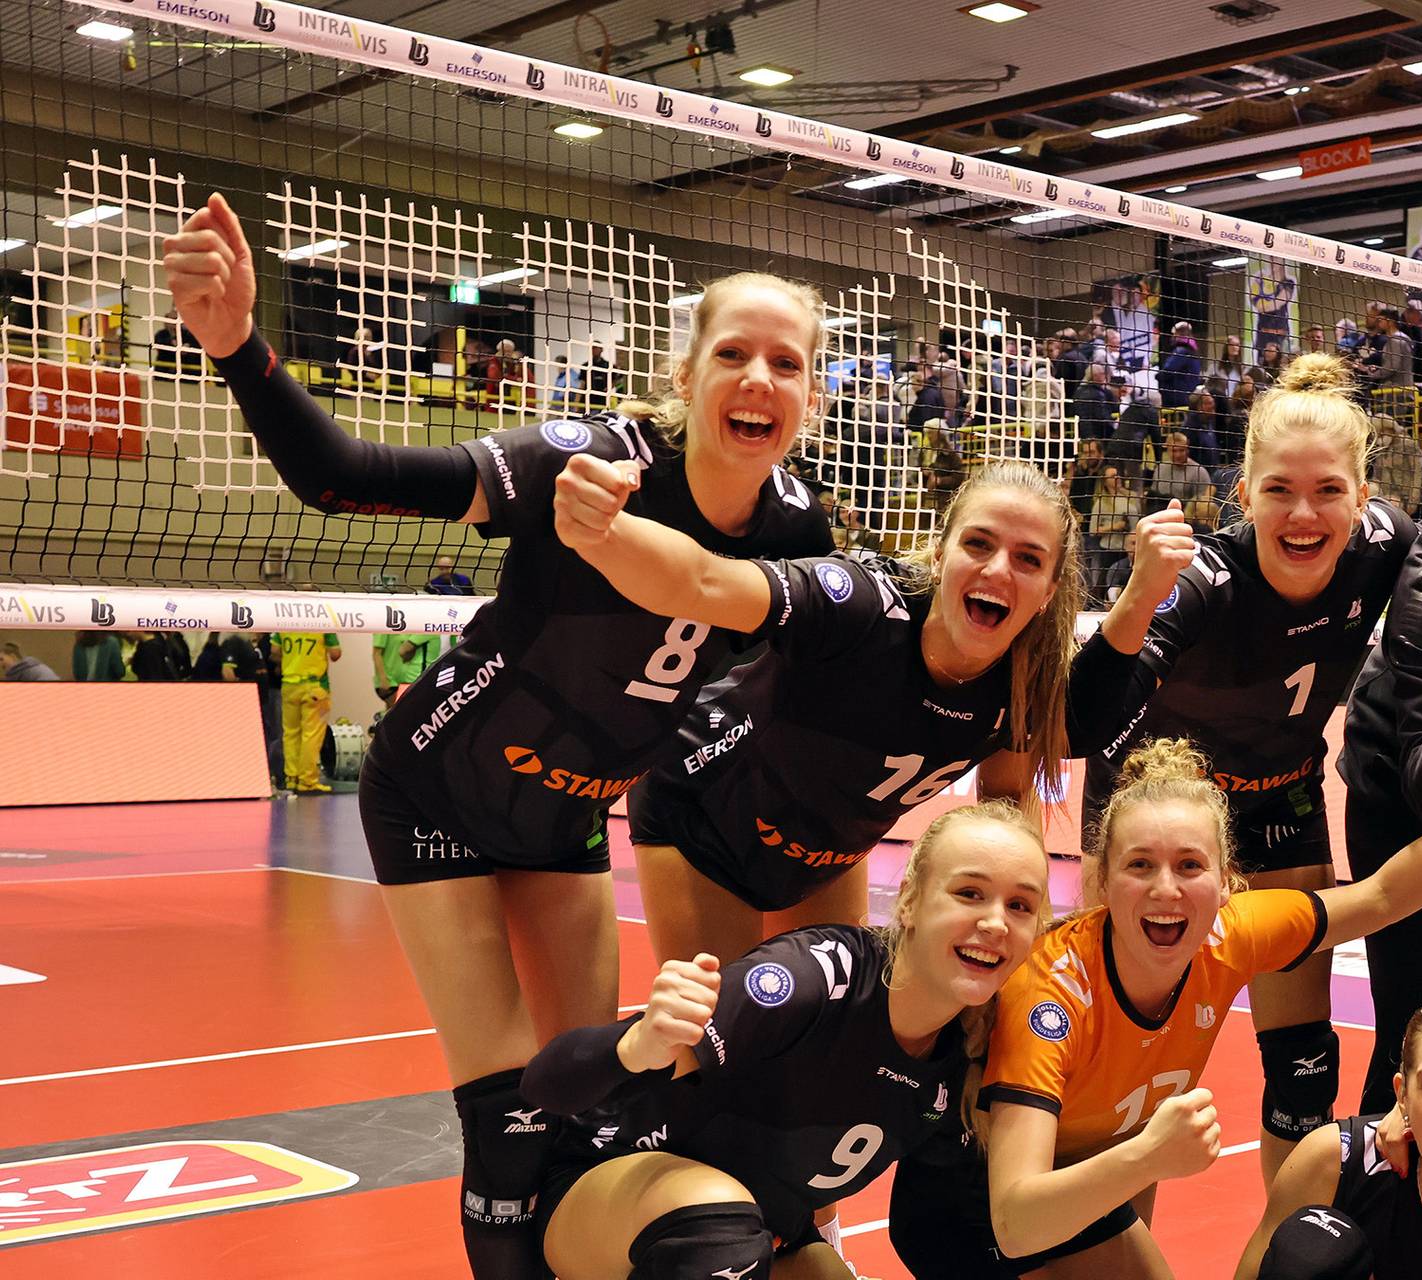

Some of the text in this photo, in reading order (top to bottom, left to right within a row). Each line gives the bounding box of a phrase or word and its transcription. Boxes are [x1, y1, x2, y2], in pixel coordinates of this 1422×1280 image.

[156, 0, 230, 24] EMERSON
[446, 63, 507, 83] EMERSON
[687, 114, 740, 132] EMERSON
[892, 157, 937, 175] EMERSON
[1067, 196, 1107, 213] EMERSON
[1302, 144, 1367, 173] BLOCK A
[136, 617, 209, 629] EMERSON
[424, 622, 465, 633] EMERS
[1287, 616, 1330, 636] STANNO
[283, 636, 318, 657] 017
[623, 617, 712, 703] 18
[410, 652, 506, 752] EMERSON
[1284, 662, 1317, 717] 1
[922, 699, 974, 721] STANNO
[543, 768, 641, 799] STAW
[867, 753, 971, 806] 16
[783, 841, 870, 869] STAW
[877, 1066, 920, 1089] STANNO
[503, 1123, 547, 1134] MIZUNO
[1271, 1119, 1300, 1132] WORLD
[807, 1123, 884, 1190] 9
[463, 1207, 493, 1224] WORLD
[495, 1216, 508, 1225] OF
